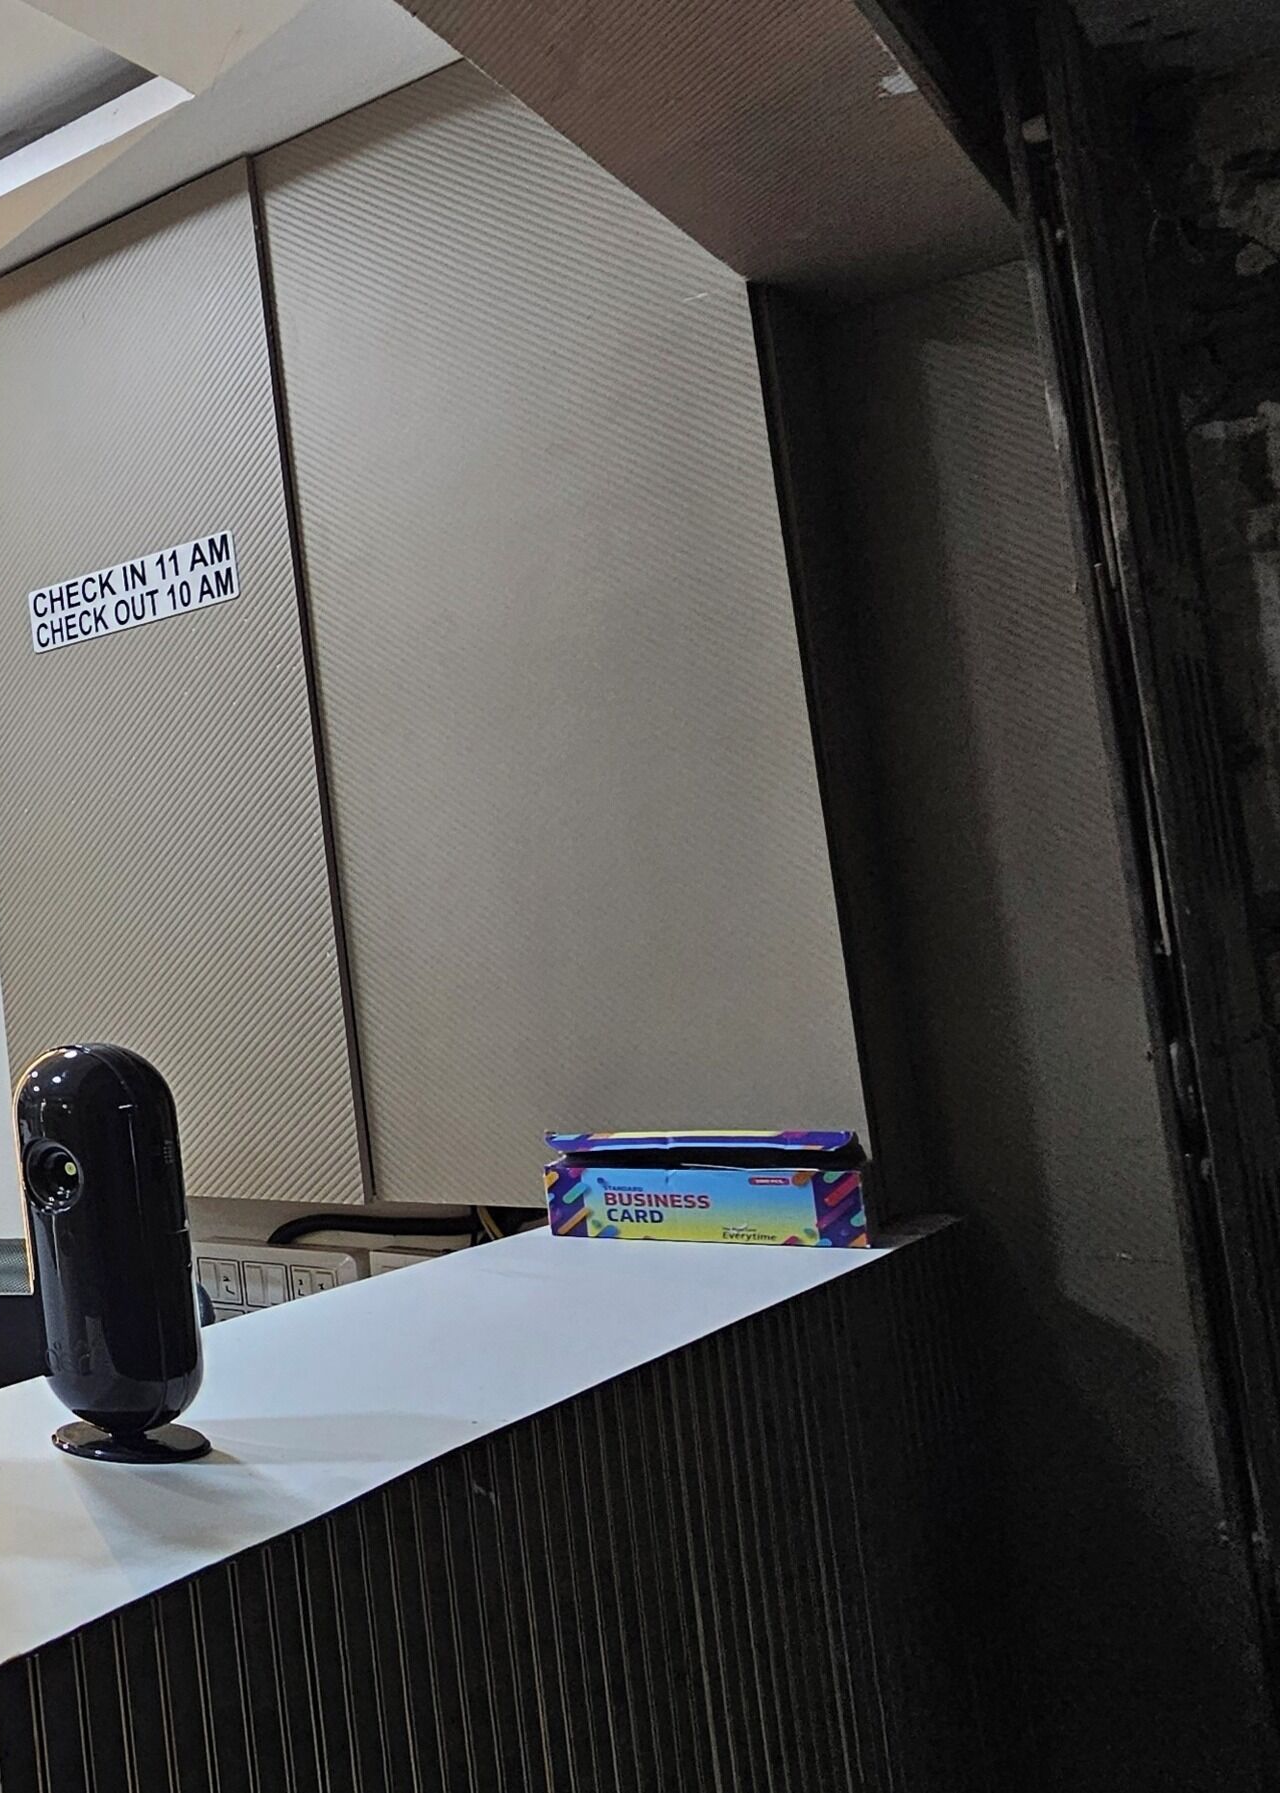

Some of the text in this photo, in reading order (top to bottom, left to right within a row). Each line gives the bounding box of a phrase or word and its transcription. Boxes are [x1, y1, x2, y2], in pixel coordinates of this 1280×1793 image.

[33, 533, 231, 618] CHECK IN 11 AM
[36, 567, 235, 648] CHECK OUT 10 AM
[604, 1192, 711, 1209] BUSINESS
[606, 1208, 664, 1224] CARD
[722, 1231, 777, 1241] Everytime
